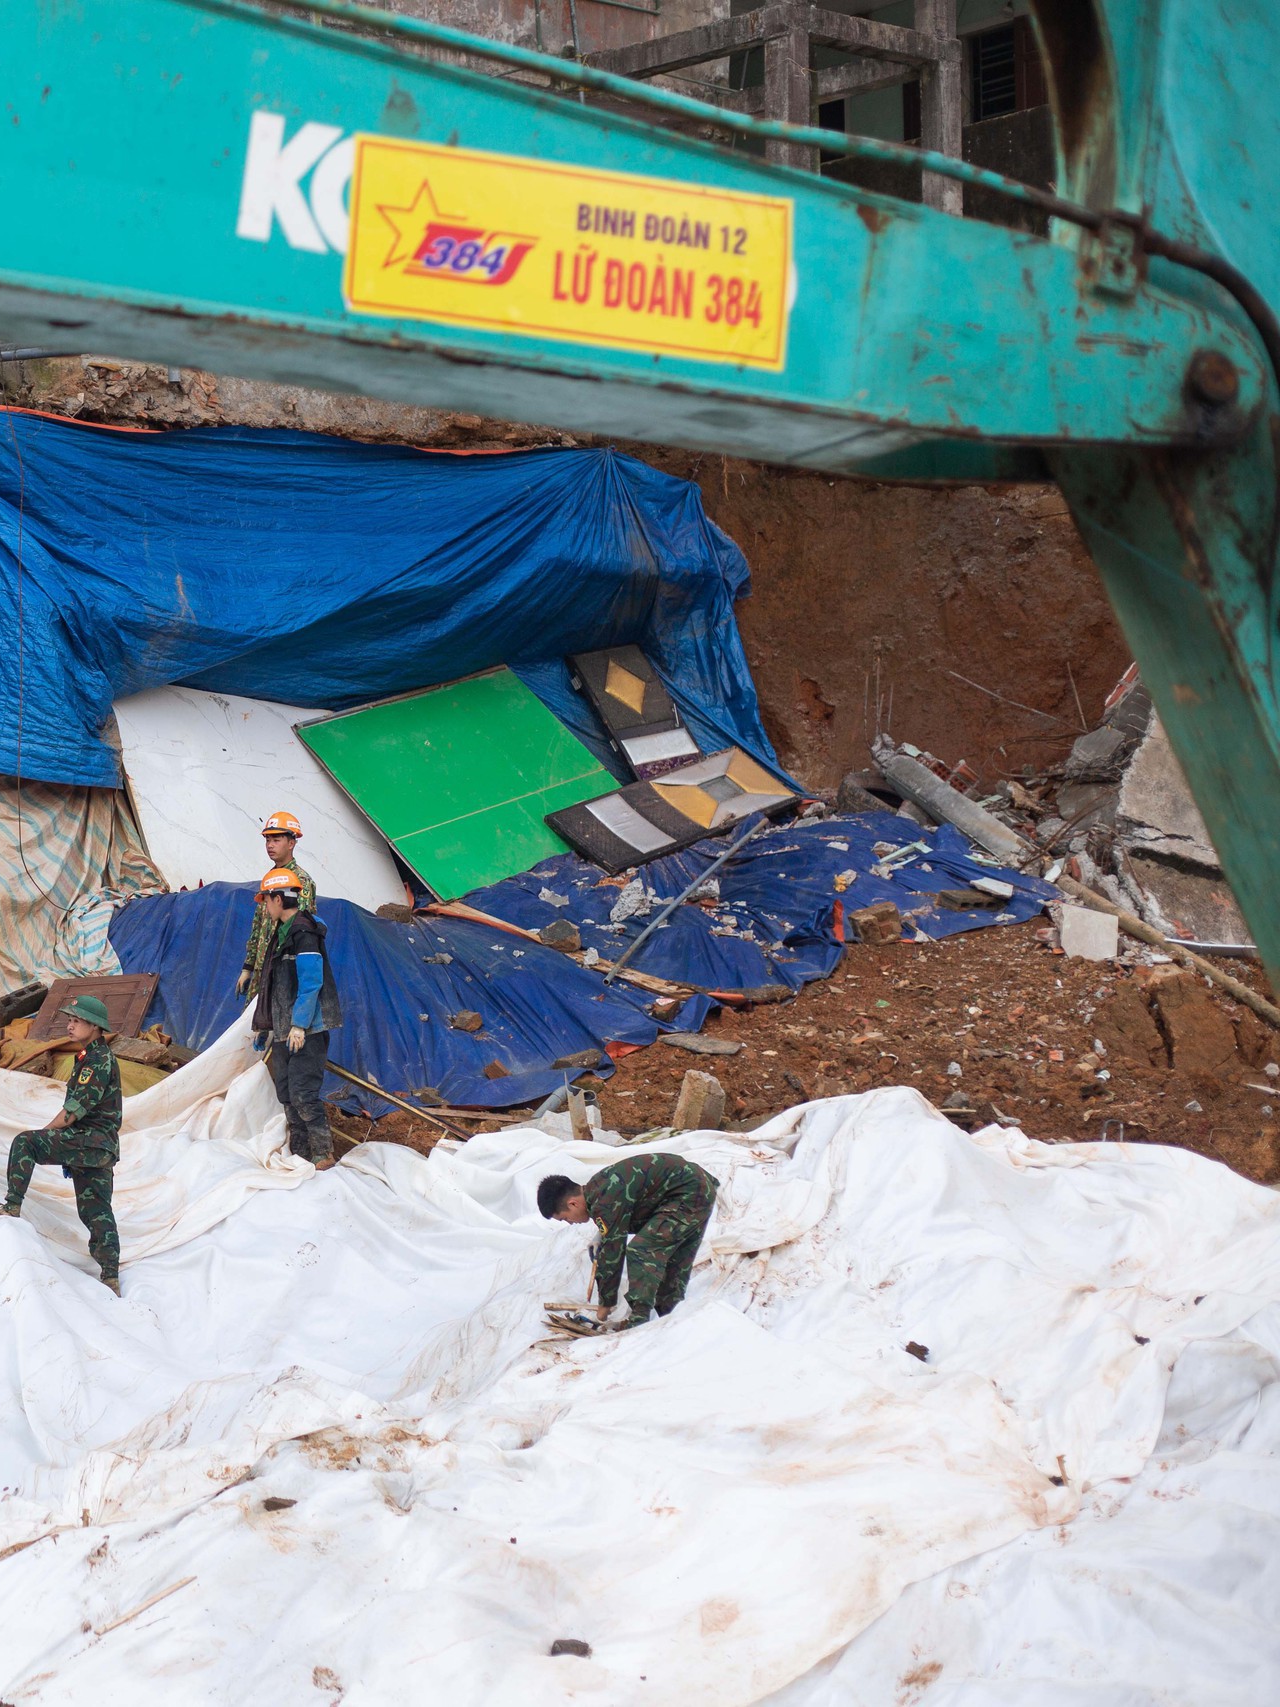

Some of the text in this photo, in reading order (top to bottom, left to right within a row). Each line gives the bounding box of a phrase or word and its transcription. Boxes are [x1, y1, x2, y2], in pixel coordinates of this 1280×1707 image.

[424, 235, 507, 275] 384
[576, 203, 748, 256] BINH ĐOÀN 12
[552, 243, 763, 329] LỮ ĐOÀN 384
